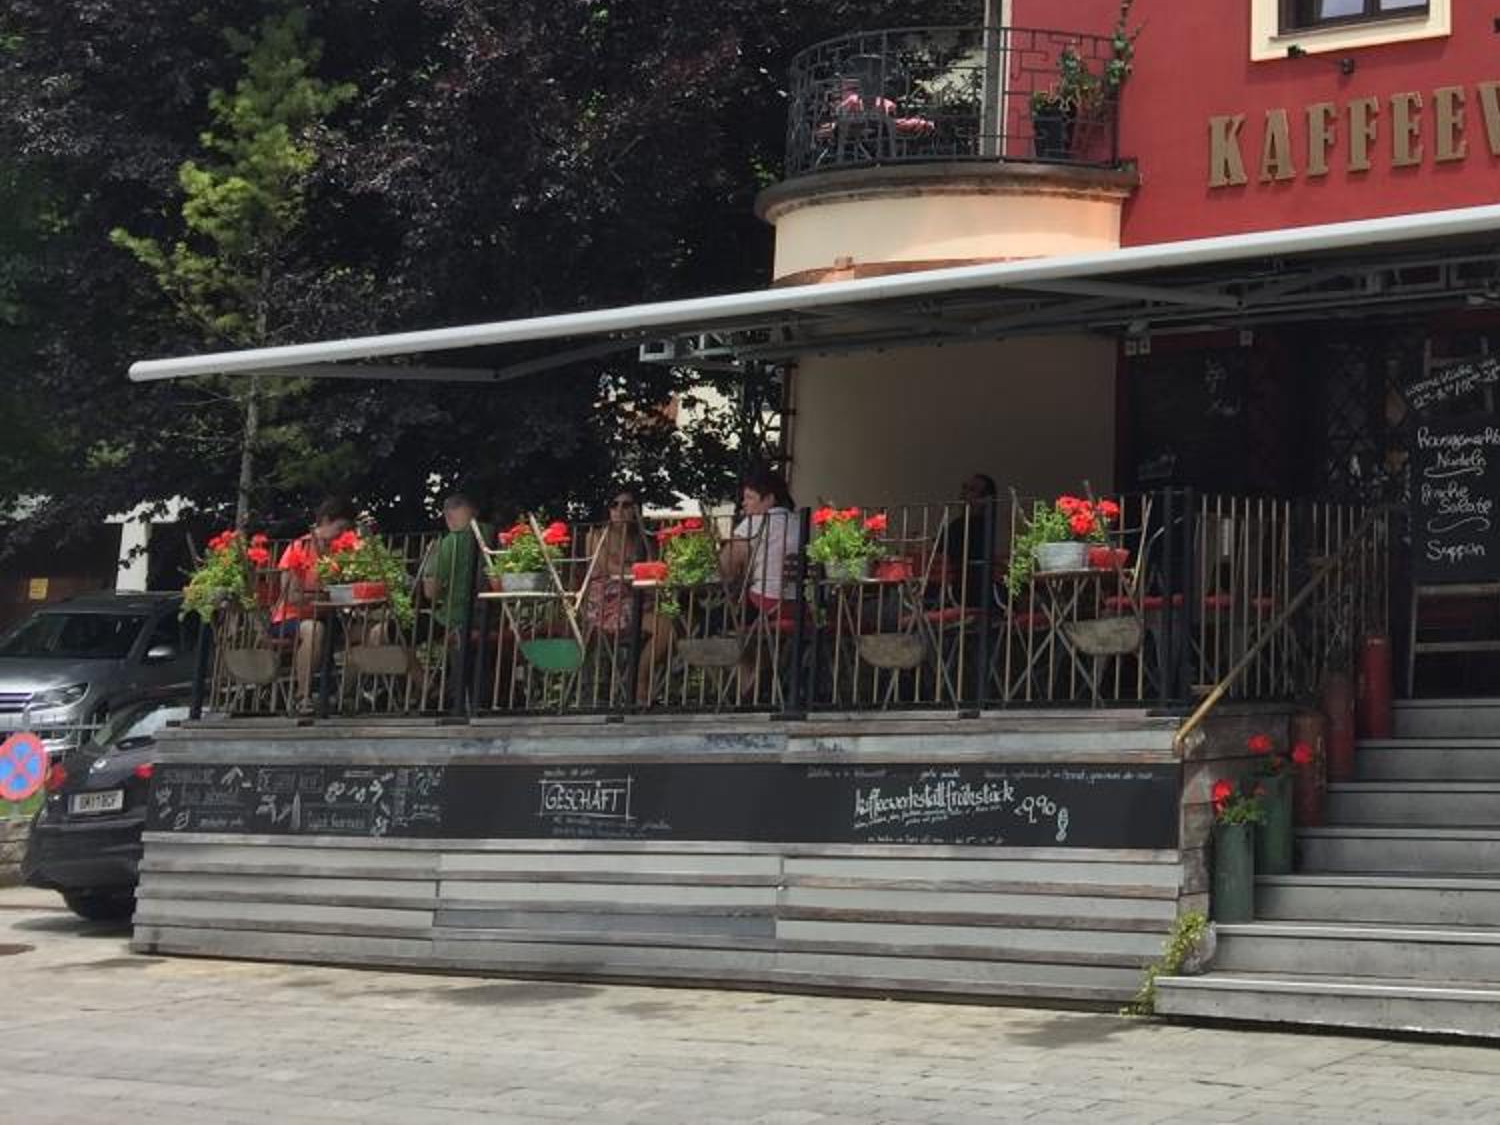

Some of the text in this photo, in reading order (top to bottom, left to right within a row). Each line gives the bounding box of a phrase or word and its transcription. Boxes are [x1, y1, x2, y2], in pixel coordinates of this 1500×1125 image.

[1437, 448, 1487, 468] Nudeln
[1438, 495, 1493, 516] Salate
[1426, 539, 1485, 563] Suppen
[544, 779, 625, 812] GESCHÄFT
